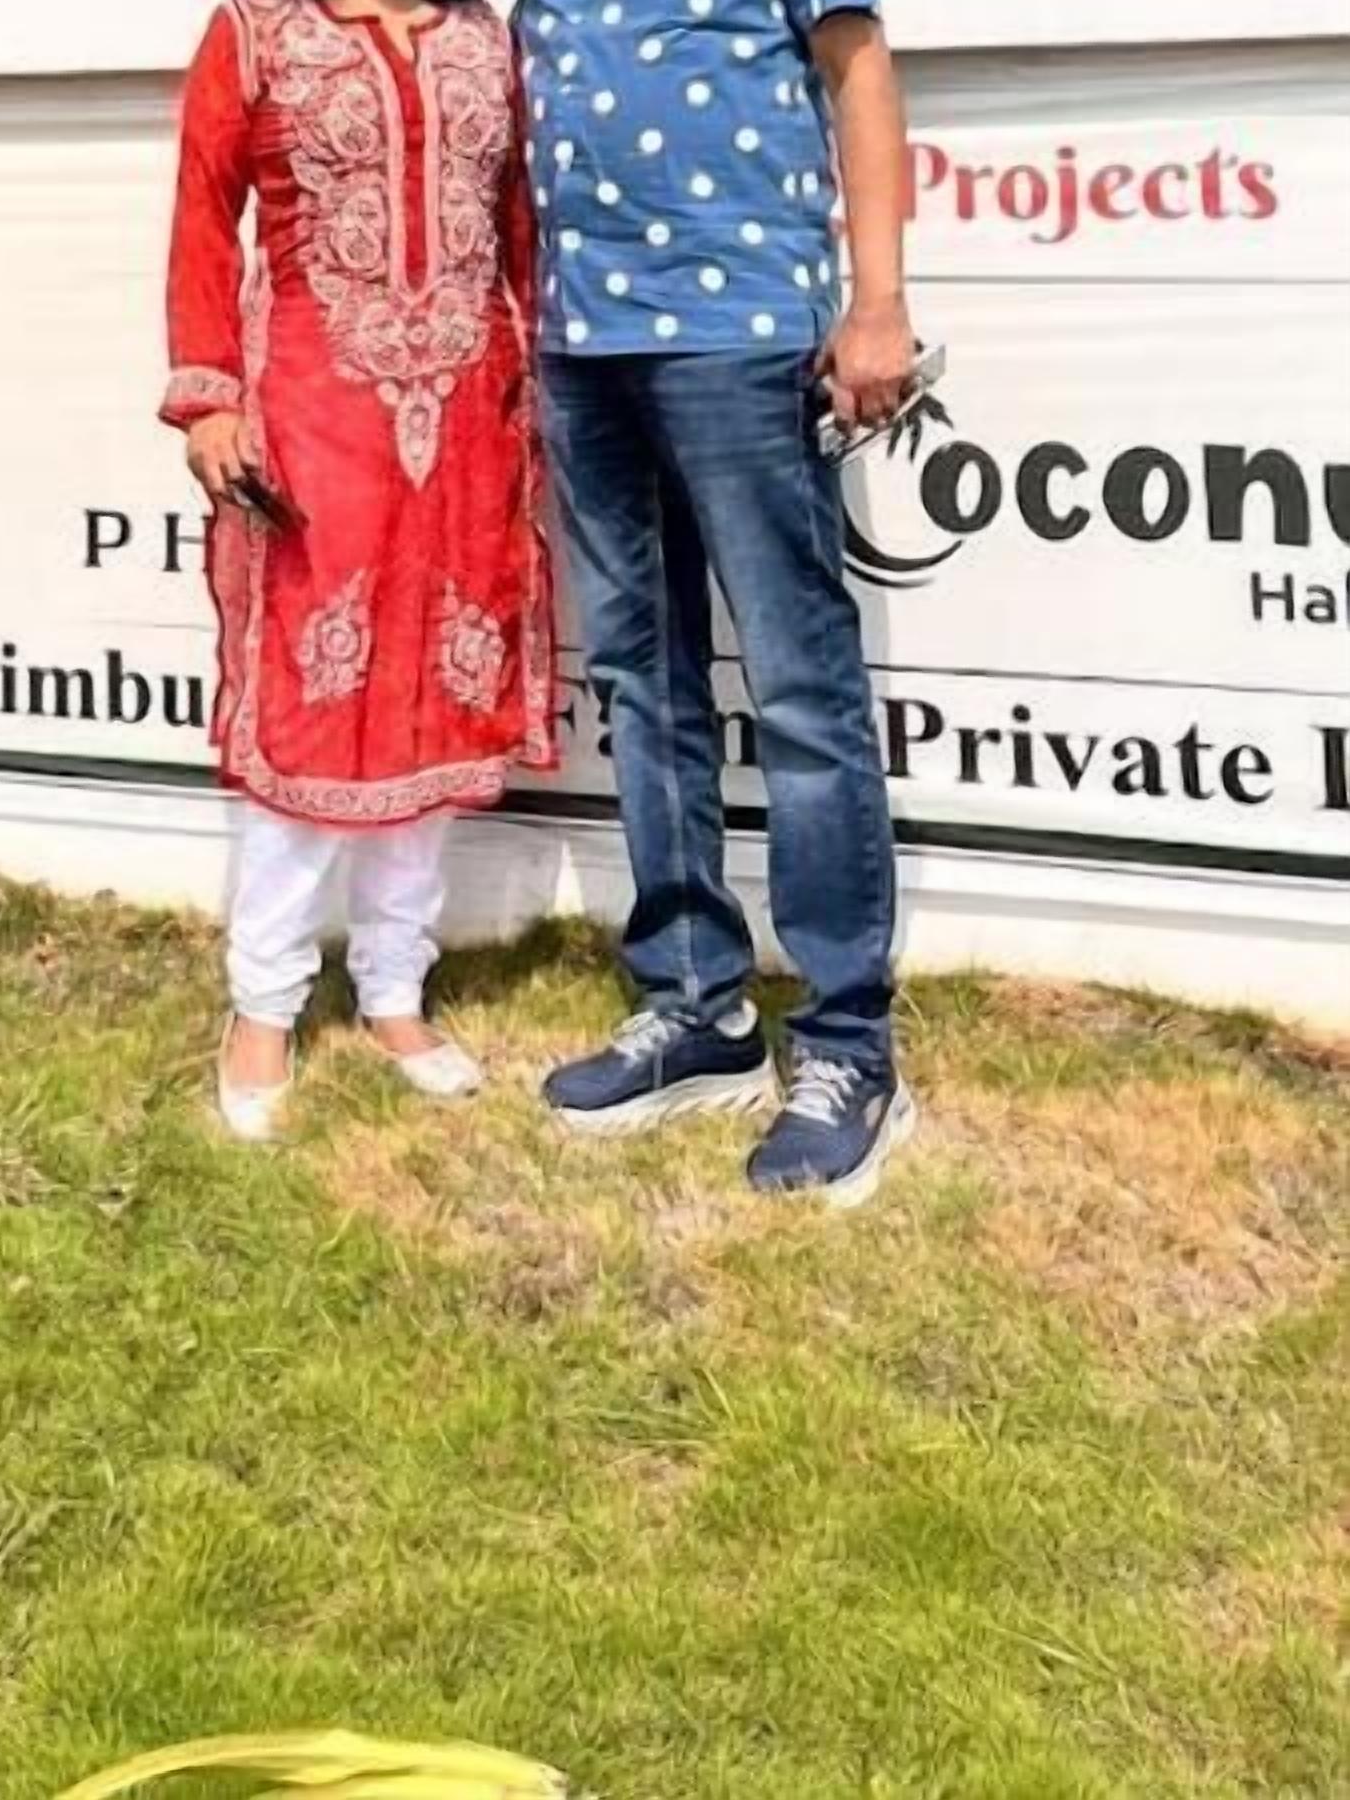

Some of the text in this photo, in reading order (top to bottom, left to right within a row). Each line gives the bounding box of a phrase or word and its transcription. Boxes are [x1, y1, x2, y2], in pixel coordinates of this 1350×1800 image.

[902, 141, 1279, 244] Projects
[843, 394, 1350, 572] ocon
[882, 697, 1275, 805] Private
